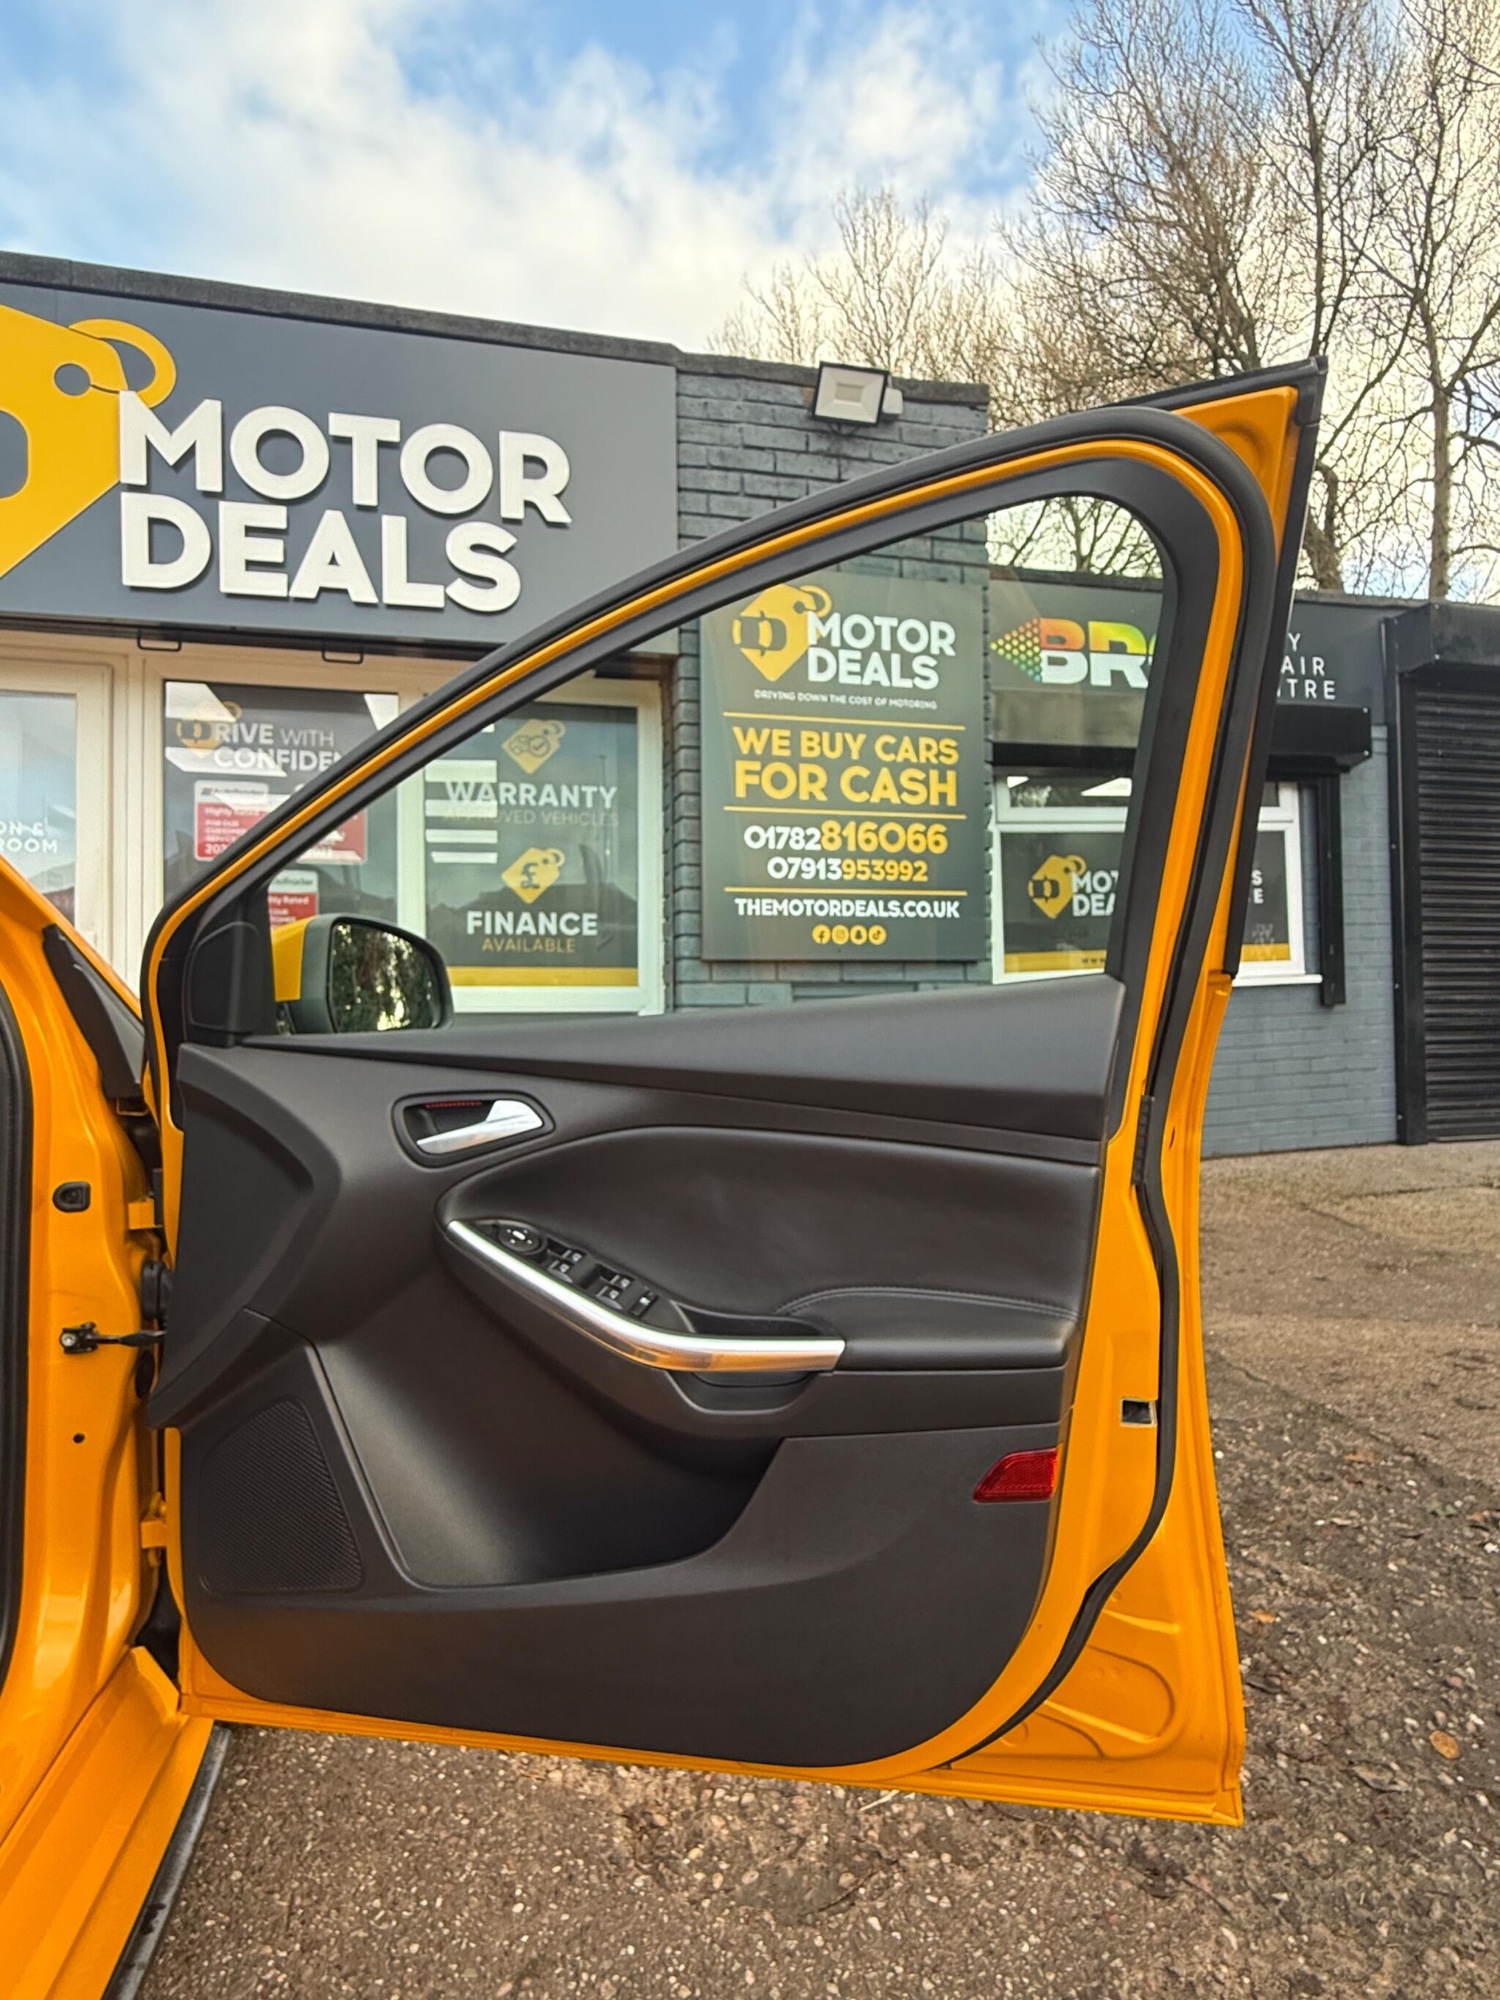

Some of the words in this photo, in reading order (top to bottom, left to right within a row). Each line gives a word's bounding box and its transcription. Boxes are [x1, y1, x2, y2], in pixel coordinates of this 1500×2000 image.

[119, 389, 573, 525] MOTOR
[120, 491, 522, 613] DEALS
[807, 611, 957, 656] MOTOR
[1039, 616, 1157, 689] BR
[807, 647, 940, 690] DEALS
[754, 689, 796, 701] DRIVING
[797, 692, 828, 703] DOWN
[829, 694, 847, 705] THE
[849, 695, 873, 706] COST
[874, 696, 887, 707] OF
[889, 697, 938, 710] MOTORING
[280, 728, 335, 748] WITH
[732, 726, 791, 756] WE
[800, 730, 867, 760] BUY
[874, 734, 960, 765] CARS
[445, 781, 618, 809] WARRANTY
[735, 760, 828, 802] FOR
[840, 765, 957, 807] CASH
[541, 810, 620, 828] VEHICLES
[743, 820, 949, 854] 01782816066
[767, 856, 928, 882] 07913953992
[466, 910, 598, 937] FINANCE
[734, 897, 961, 919] THEMOTORDEALS.CO.UK
[482, 937, 577, 954] AVAILABLE
